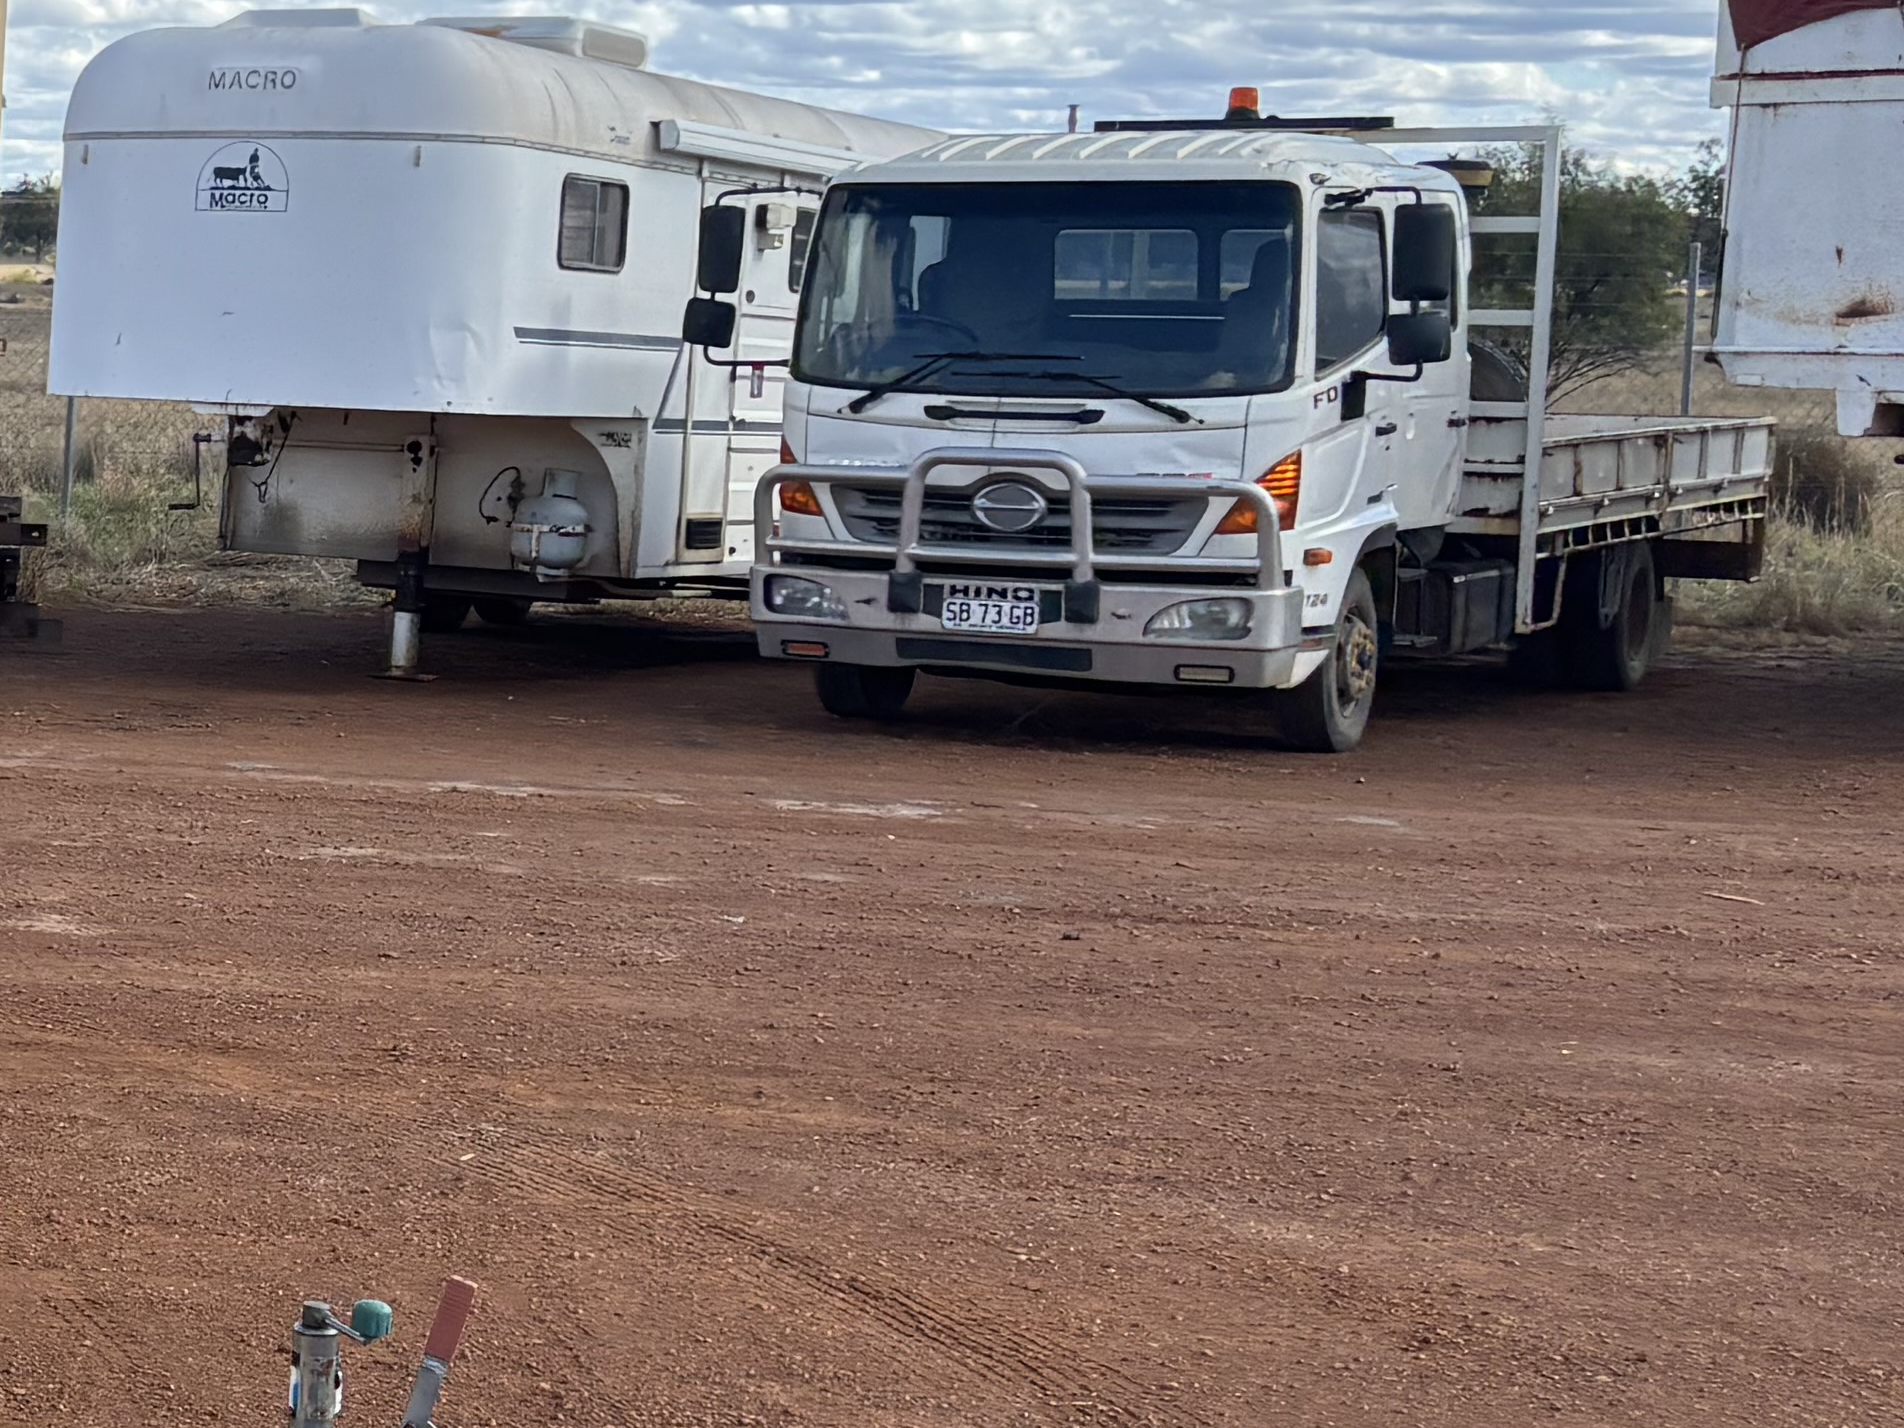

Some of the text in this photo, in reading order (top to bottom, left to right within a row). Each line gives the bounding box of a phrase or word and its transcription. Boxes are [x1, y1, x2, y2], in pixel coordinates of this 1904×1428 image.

[208, 69, 297, 91] MACRO
[209, 191, 269, 209] Macro
[1313, 385, 1338, 410] FD
[949, 584, 1035, 602] HINO
[946, 601, 1035, 626] SB 73 GB
